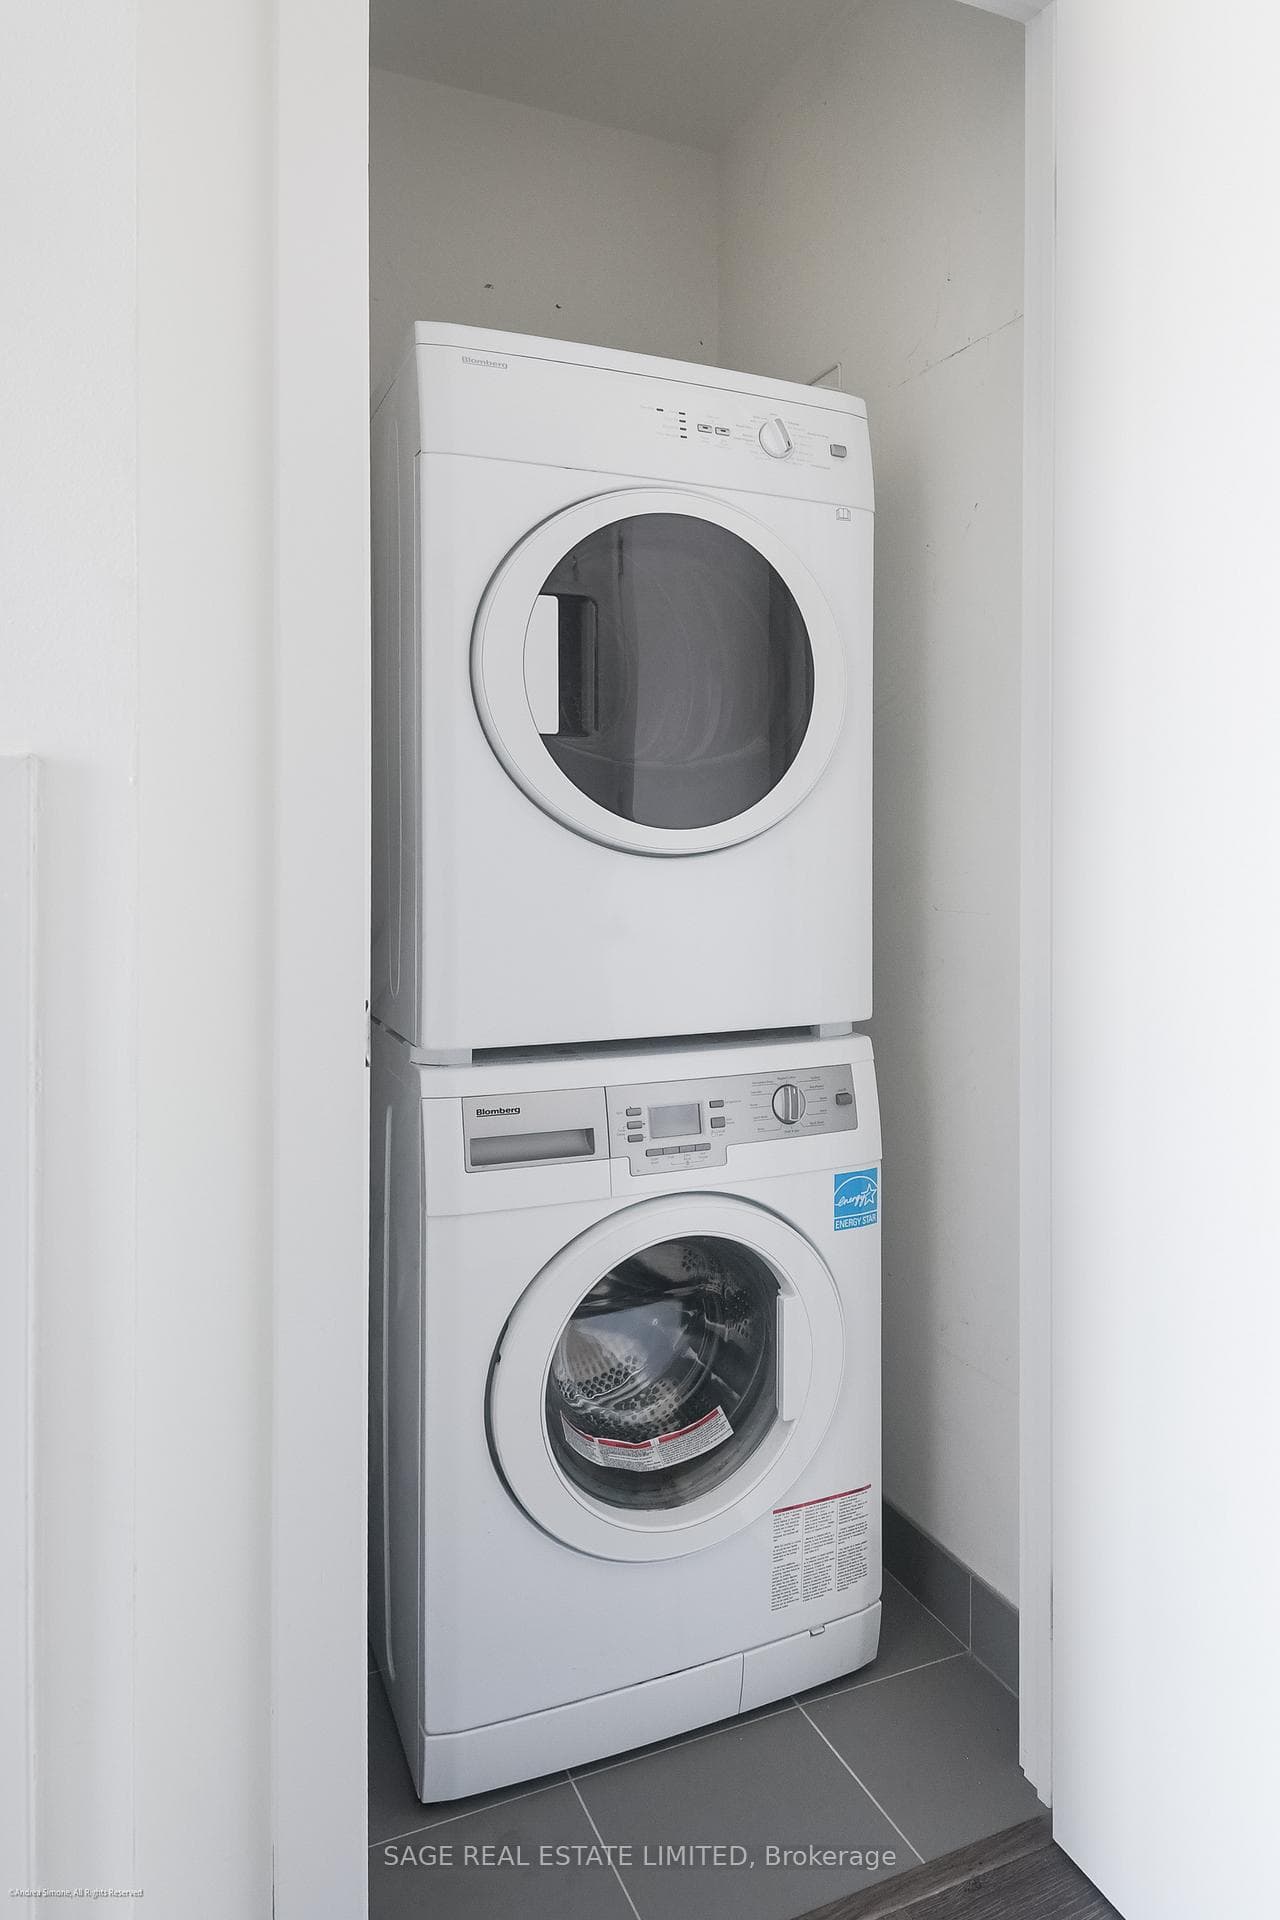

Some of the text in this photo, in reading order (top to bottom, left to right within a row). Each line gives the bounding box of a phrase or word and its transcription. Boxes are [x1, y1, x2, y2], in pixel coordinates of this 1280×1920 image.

[476, 1107, 521, 1118] Blomberg
[835, 1213, 877, 1230] ENERGY STAR
